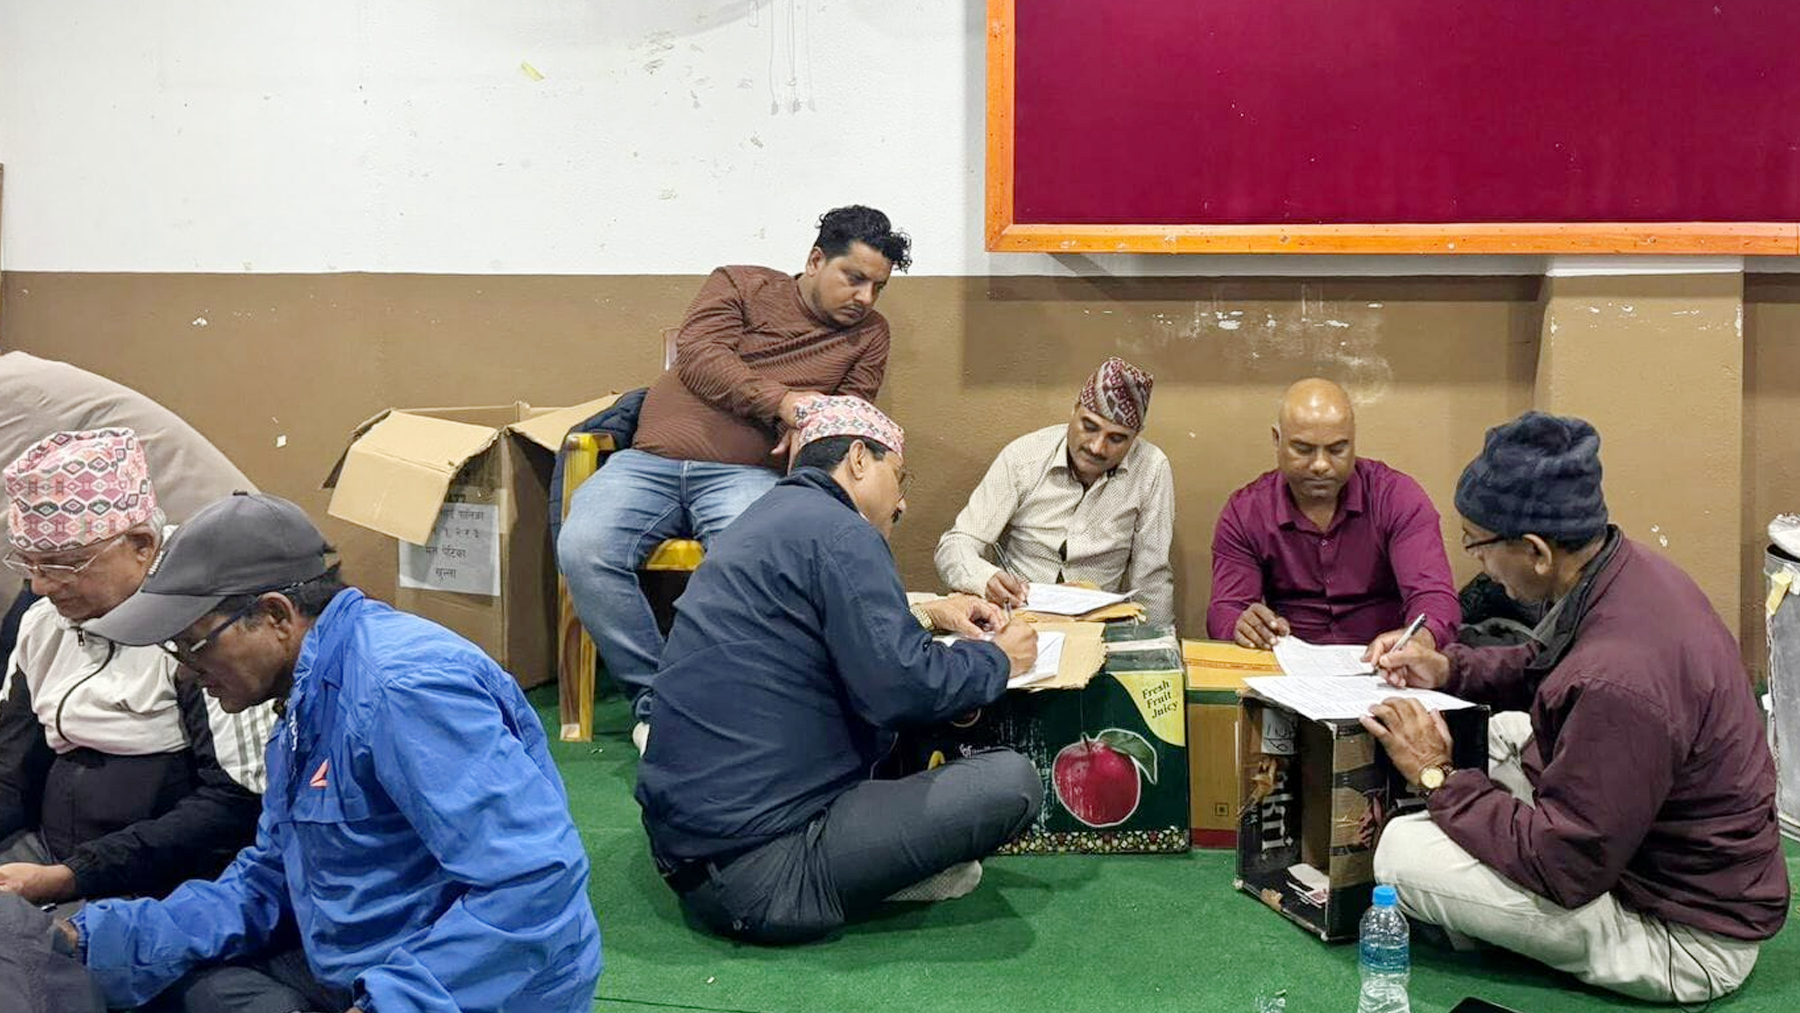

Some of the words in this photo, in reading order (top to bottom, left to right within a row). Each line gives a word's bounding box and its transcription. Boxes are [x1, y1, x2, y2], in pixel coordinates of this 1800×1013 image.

[1142, 680, 1170, 699] Fresh
[1147, 691, 1172, 709] Fruit
[1152, 701, 1178, 719] Juicy
